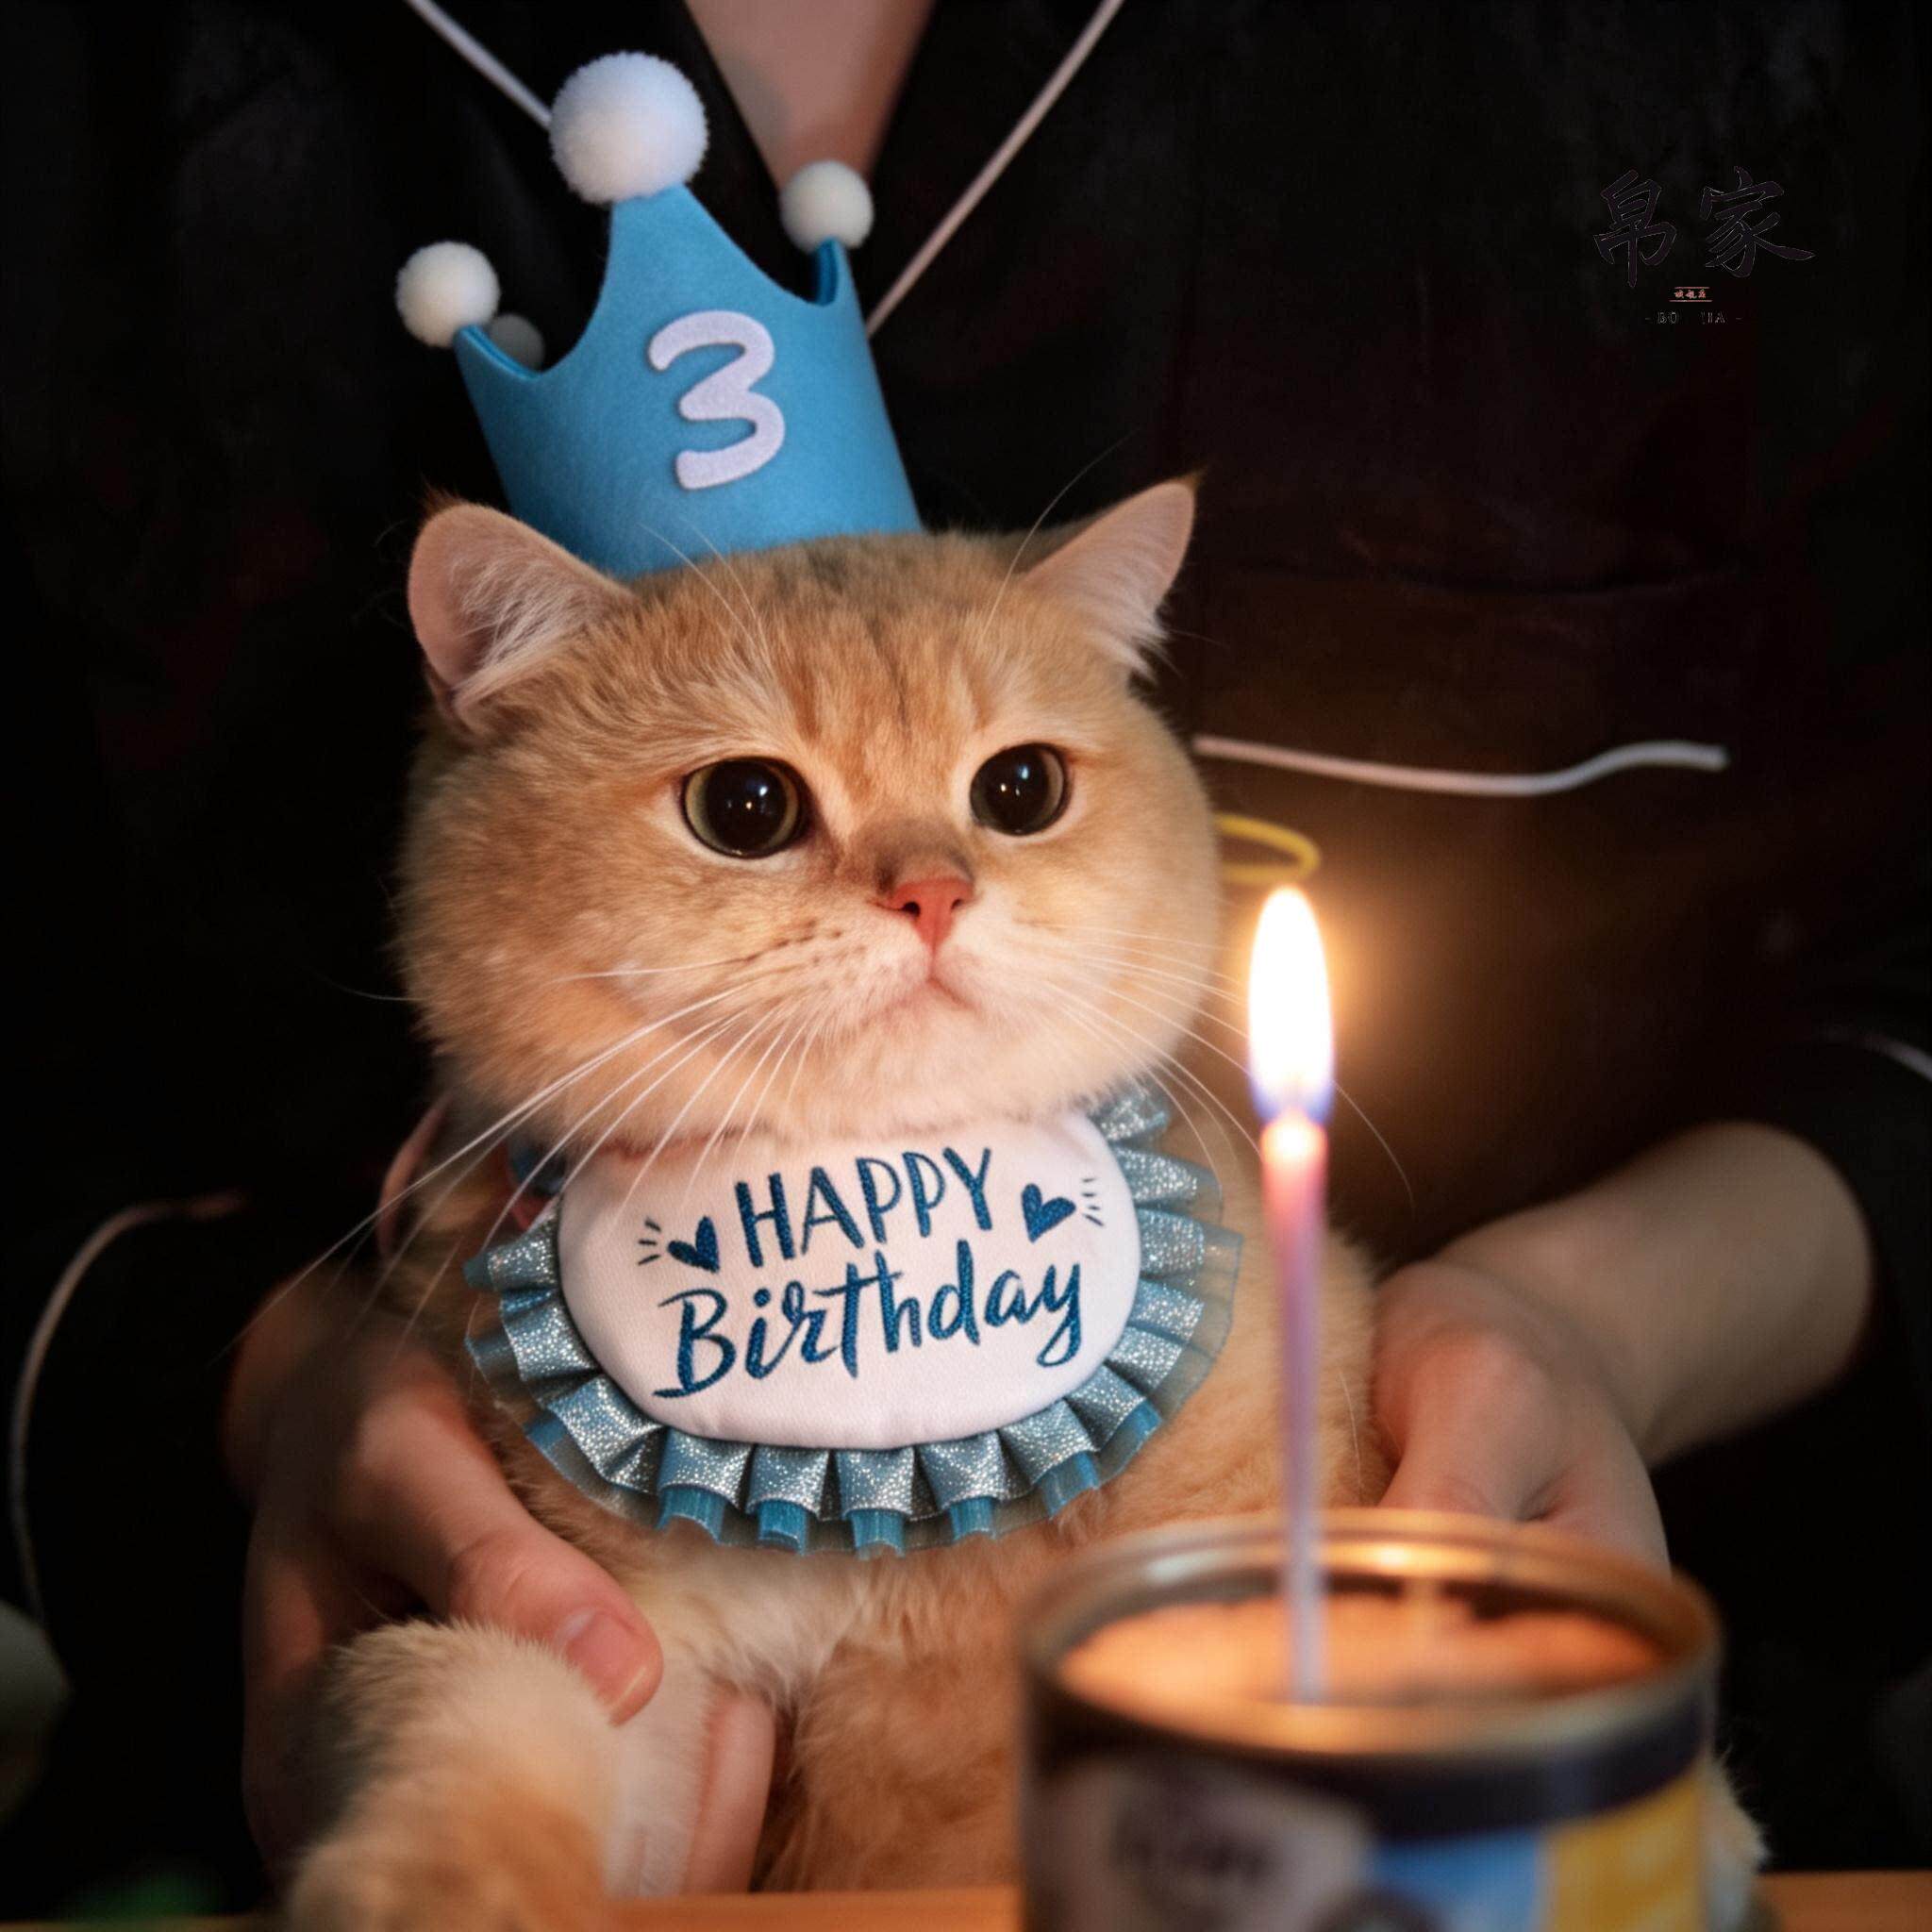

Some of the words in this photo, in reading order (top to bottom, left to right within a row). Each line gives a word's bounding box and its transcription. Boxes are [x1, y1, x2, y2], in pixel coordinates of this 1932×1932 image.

[647, 309, 785, 490] 3
[735, 1148, 991, 1267] HAPPY
[653, 1240, 1082, 1398] Birthday
